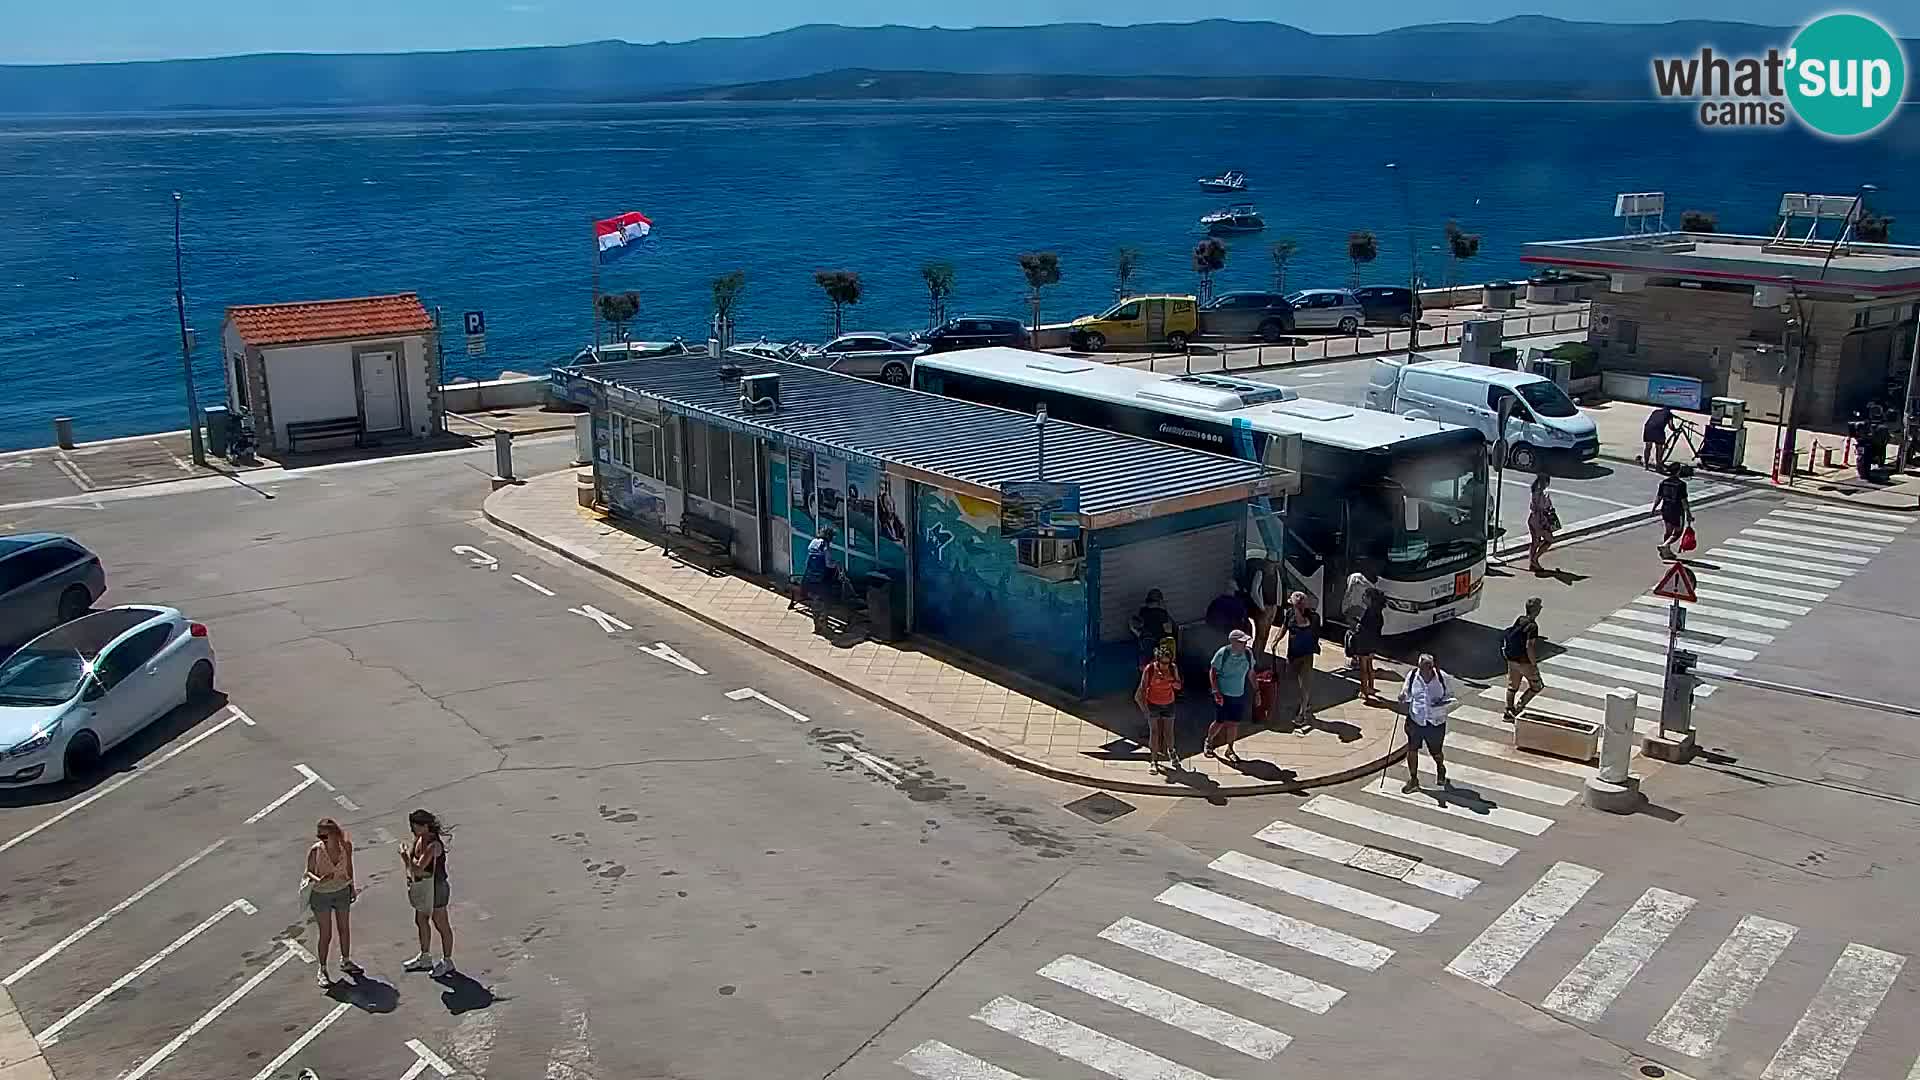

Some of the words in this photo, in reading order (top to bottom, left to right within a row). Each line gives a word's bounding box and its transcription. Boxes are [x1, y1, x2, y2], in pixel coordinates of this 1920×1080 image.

[469, 314, 480, 332] P
[799, 439, 828, 455] STATION
[830, 446, 855, 461] TICKET
[855, 454, 882, 469] OFFICE
